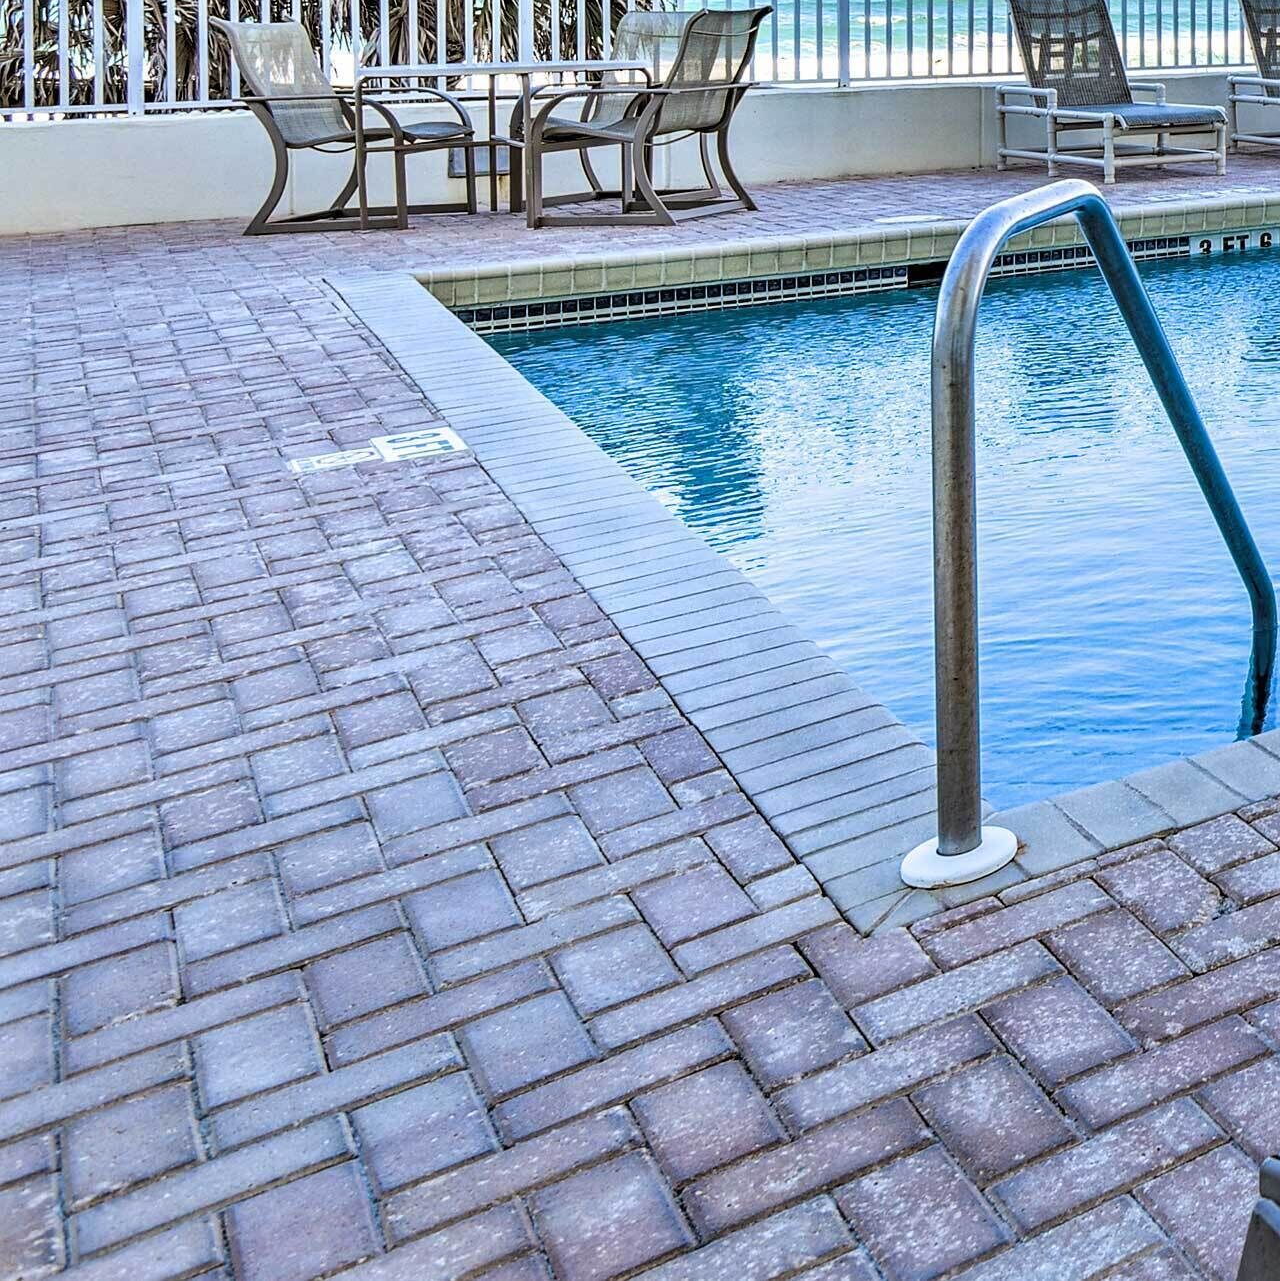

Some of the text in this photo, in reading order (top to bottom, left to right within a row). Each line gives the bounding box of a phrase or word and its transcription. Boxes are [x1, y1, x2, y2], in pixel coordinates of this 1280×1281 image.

[1199, 239, 1212, 254] 3
[1222, 234, 1250, 252] FT
[1260, 232, 1272, 248] 6
